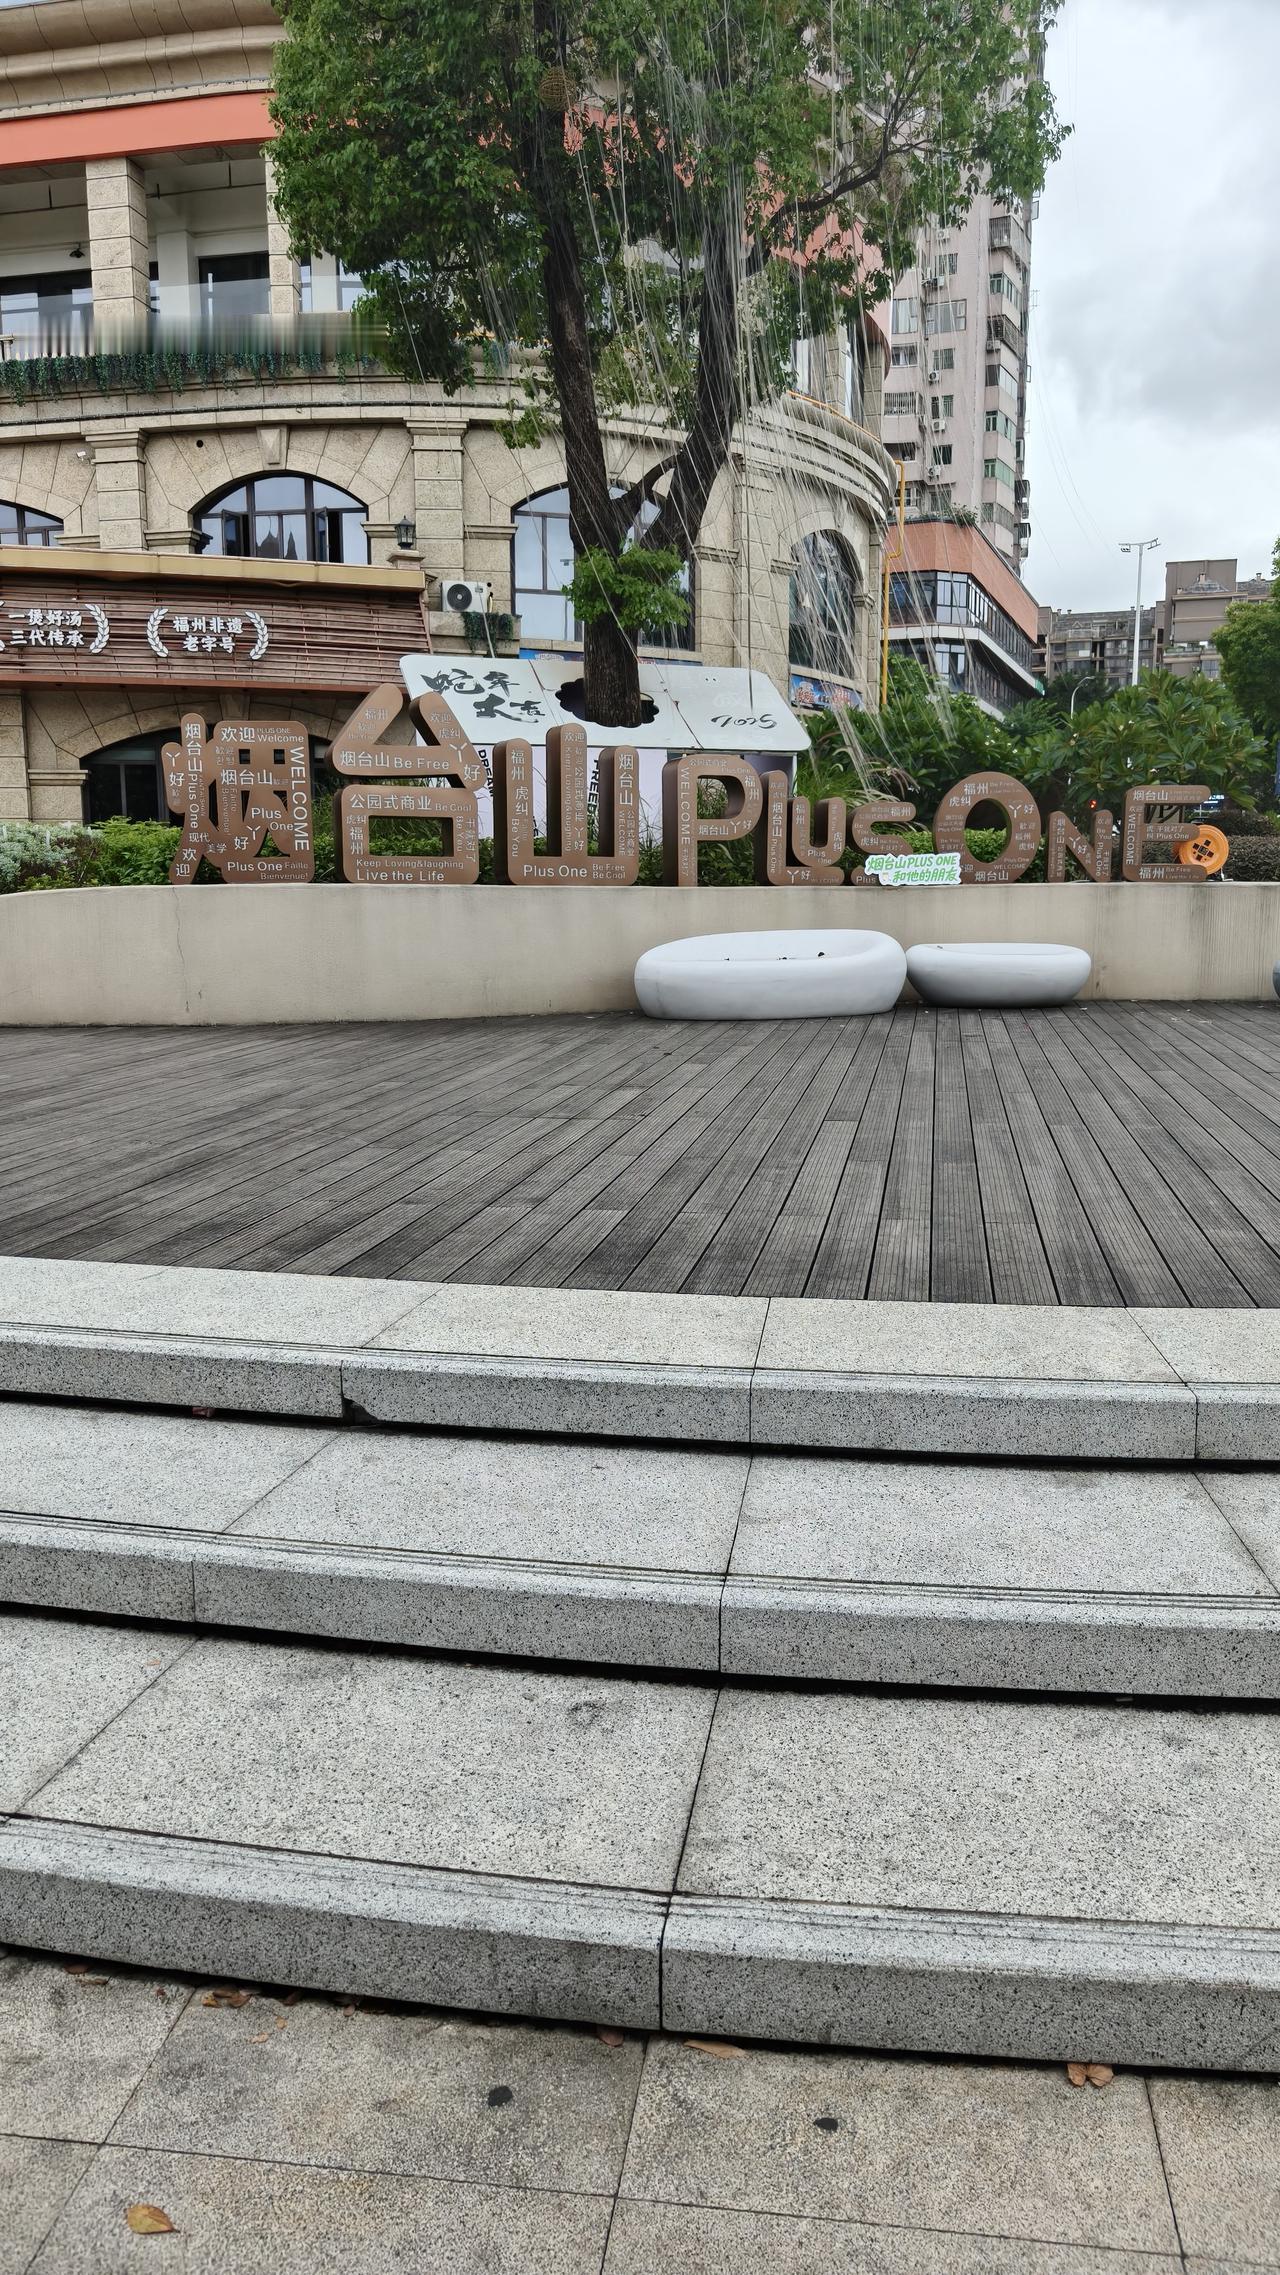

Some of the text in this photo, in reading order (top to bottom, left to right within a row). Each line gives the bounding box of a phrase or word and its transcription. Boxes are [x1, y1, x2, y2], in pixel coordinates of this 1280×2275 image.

[8, 608, 83, 627] 一煲好汤
[173, 616, 244, 635] 福州非遗
[10, 630, 85, 647] 三代传承
[183, 636, 236, 653] 老字号
[221, 726, 256, 743] 欢迎
[257, 734, 305, 743] Welcome
[564, 731, 585, 743] 欢迎
[185, 723, 203, 773] 烟台山
[340, 750, 390, 768] 烟台山
[394, 757, 450, 770] Be Free
[511, 749, 526, 780] 福州
[221, 769, 273, 785] 烟台山
[619, 753, 634, 806] 烟台山
[574, 767, 585, 822] 公园式商业
[744, 775, 760, 800] 福州
[963, 782, 989, 795] 福州
[188, 773, 199, 829] Plus One
[290, 746, 310, 851] WELCOME
[350, 793, 433, 811] 公园式商业
[515, 786, 529, 816] 虎纠
[949, 796, 971, 807] 虎纠
[1133, 790, 1169, 801] 烟台山
[251, 807, 282, 819] Plus
[435, 803, 472, 812] Be Cool
[680, 767, 691, 846] WELCOME
[891, 806, 911, 817] 福州
[270, 821, 294, 831] One
[456, 815, 465, 852] Be You
[618, 810, 626, 857] WELCOME
[699, 824, 729, 836] 烟台山
[189, 832, 210, 843] 现代
[350, 826, 364, 855] 福州
[511, 818, 520, 857] Be You
[1125, 813, 1137, 865] WELCOME
[1156, 832, 1173, 840] Plus
[207, 843, 227, 854] 美学
[808, 849, 826, 857] Plus
[176, 848, 197, 877] 欢迎
[227, 861, 255, 872] Plus
[257, 861, 283, 872] One
[356, 859, 381, 868] Keep
[606, 864, 625, 872] Free
[935, 855, 958, 866] ONE
[356, 869, 445, 881] Live the Life
[523, 864, 588, 878] Plus One
[592, 871, 604, 879] Be
[892, 867, 958, 883] 和他的朋友
[974, 870, 1009, 881] 烟台山
[1139, 867, 1165, 879] 福州
